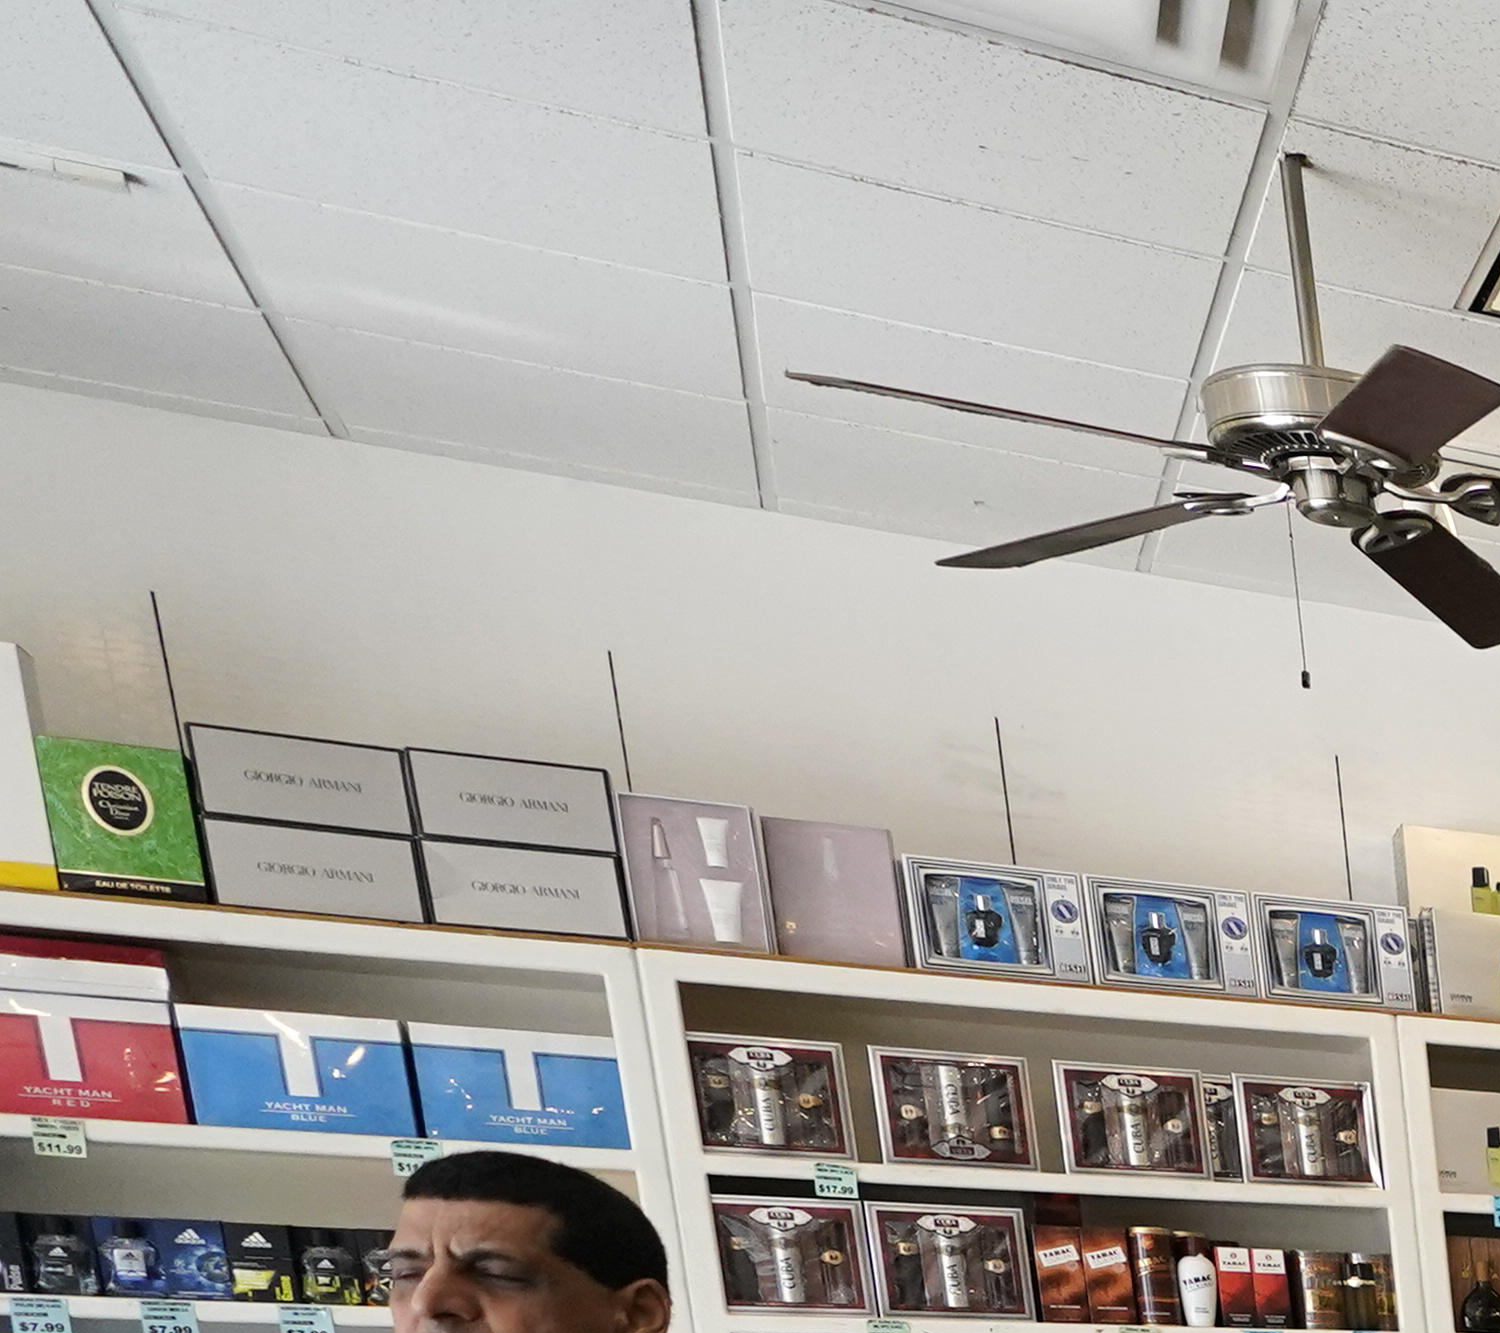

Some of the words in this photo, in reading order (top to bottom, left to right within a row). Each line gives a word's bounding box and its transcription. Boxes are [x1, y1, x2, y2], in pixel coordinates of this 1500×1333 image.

[244, 769, 303, 788] GIORGIO
[310, 778, 363, 794] ARMANI
[92, 788, 142, 801] POISON
[459, 791, 515, 808] GIORGIO
[519, 798, 569, 813] ARMANI
[257, 861, 316, 878] GIORGIO
[323, 868, 375, 883] ARMANI
[471, 880, 526, 895] GIORGIO
[531, 885, 580, 900] ARMANI
[22, 1085, 73, 1098] YACHT
[77, 1088, 113, 1100] MAN
[51, 1099, 92, 1109] RED
[489, 1114, 534, 1126] YACHT
[536, 1116, 568, 1128] MAN
[36, 1142, 83, 1157] $11.99
[818, 1184, 855, 1196] $17.99
[781, 1257, 796, 1290] CUBA
